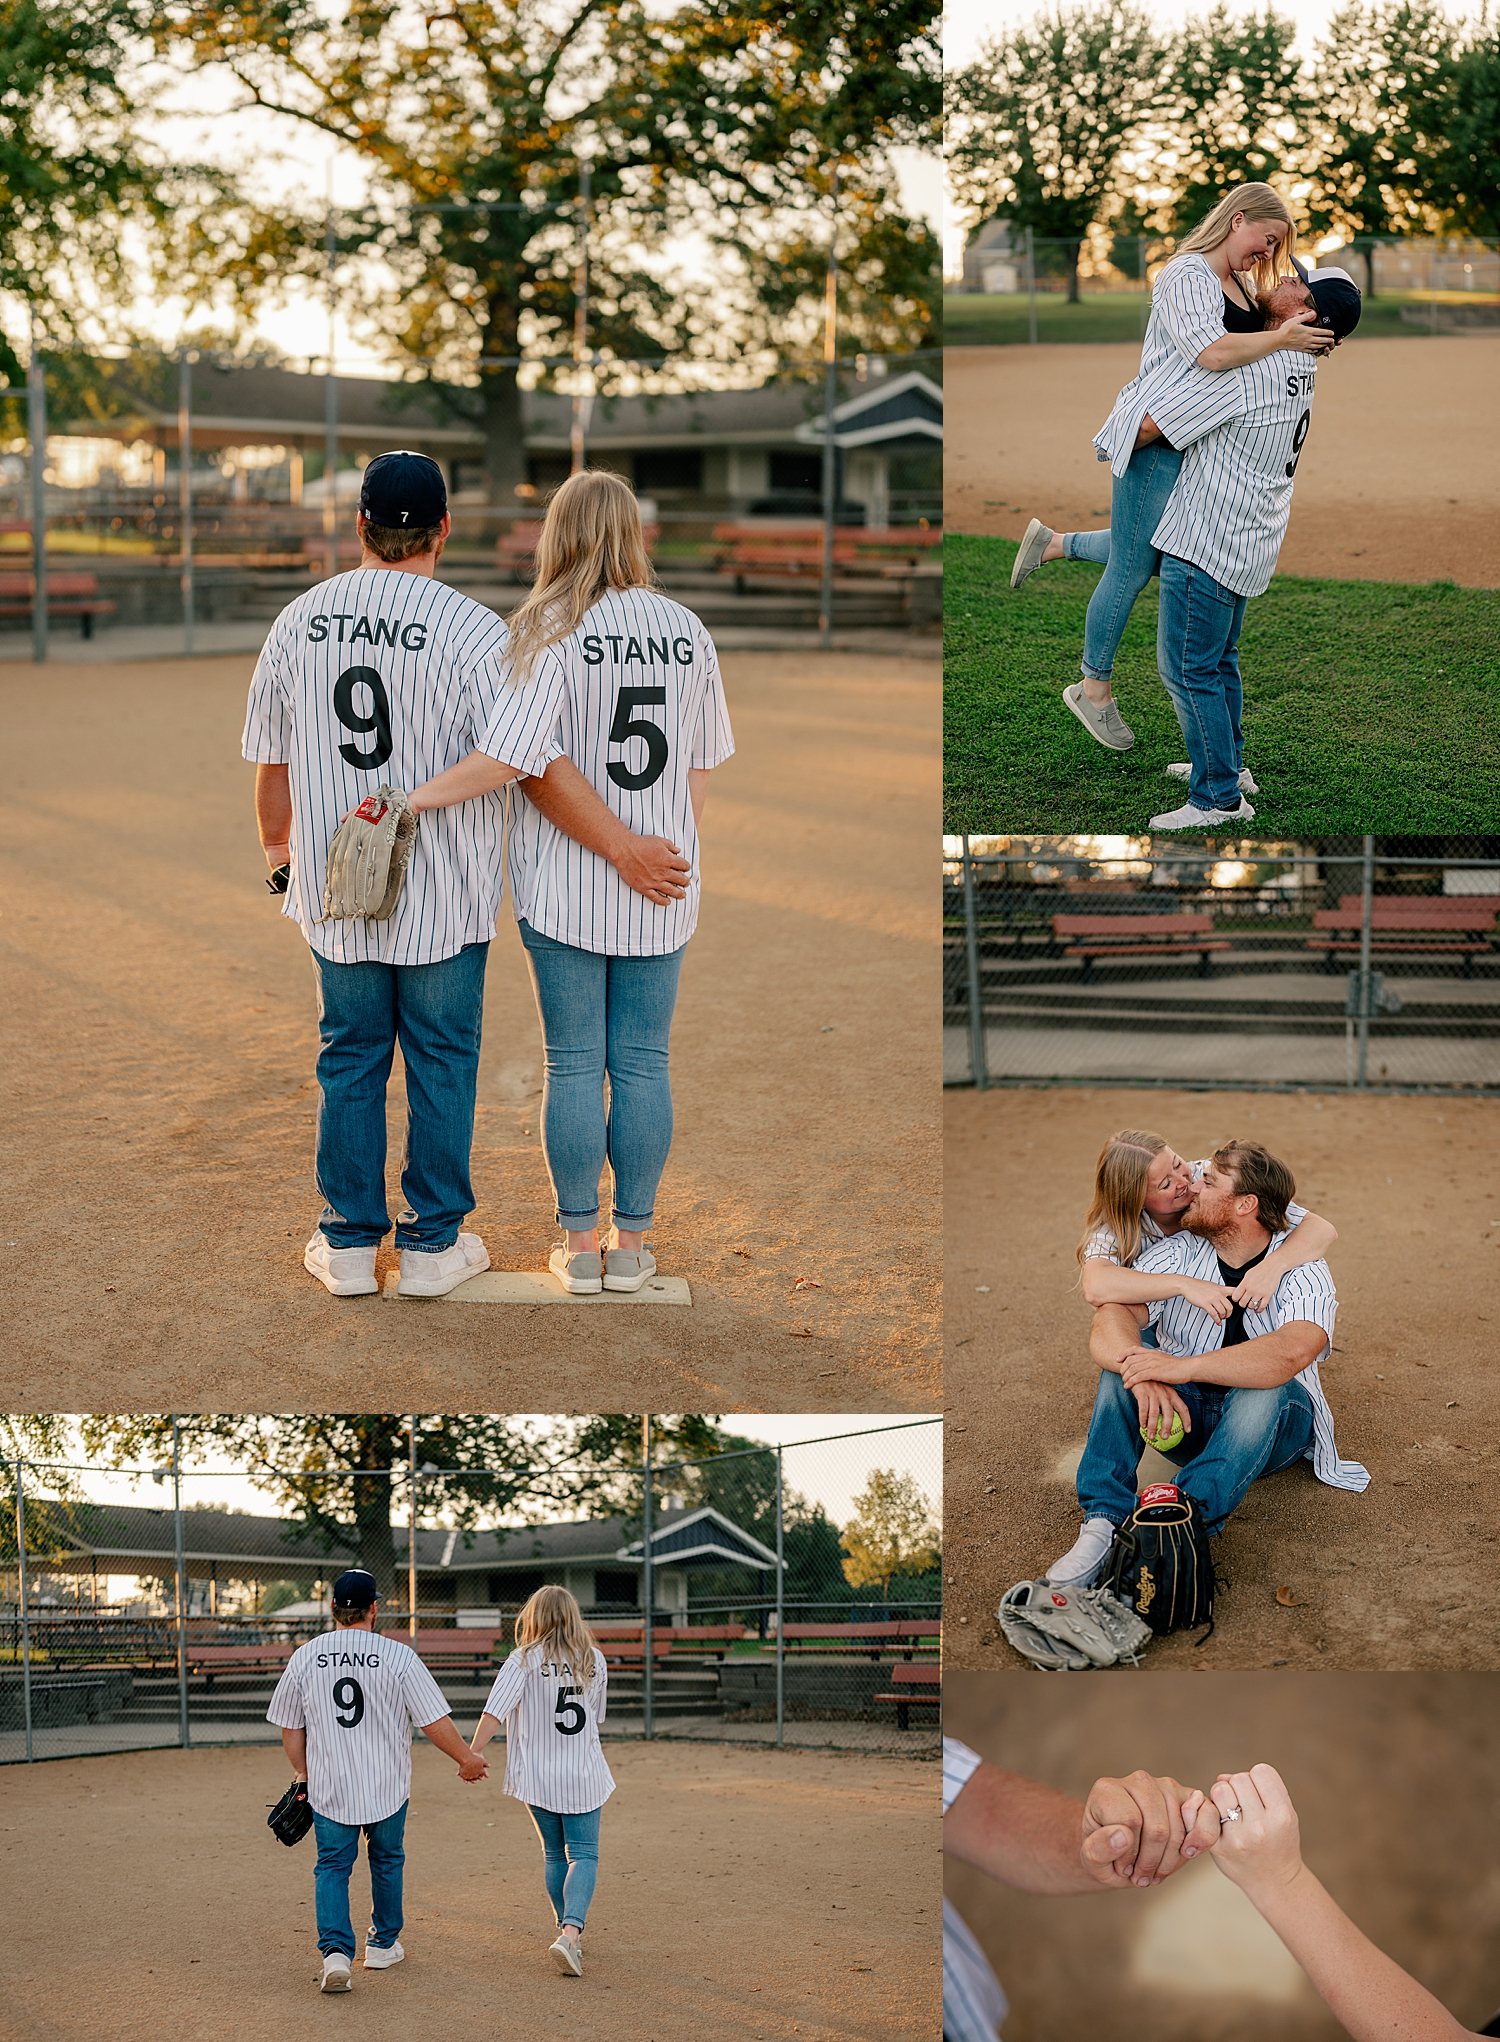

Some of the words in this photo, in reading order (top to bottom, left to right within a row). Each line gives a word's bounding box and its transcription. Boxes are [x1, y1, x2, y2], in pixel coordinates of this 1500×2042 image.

[1285, 408, 1310, 478] 9
[401, 511, 409, 523] 7
[308, 614, 428, 651] STANG
[583, 635, 693, 665] STANG
[333, 665, 393, 770] 9
[605, 686, 668, 791] 5
[1135, 1564, 1156, 1614] Rawlings
[317, 1652, 380, 1669] STANG
[332, 1677, 365, 1729] 9
[554, 1686, 586, 1735] 5
